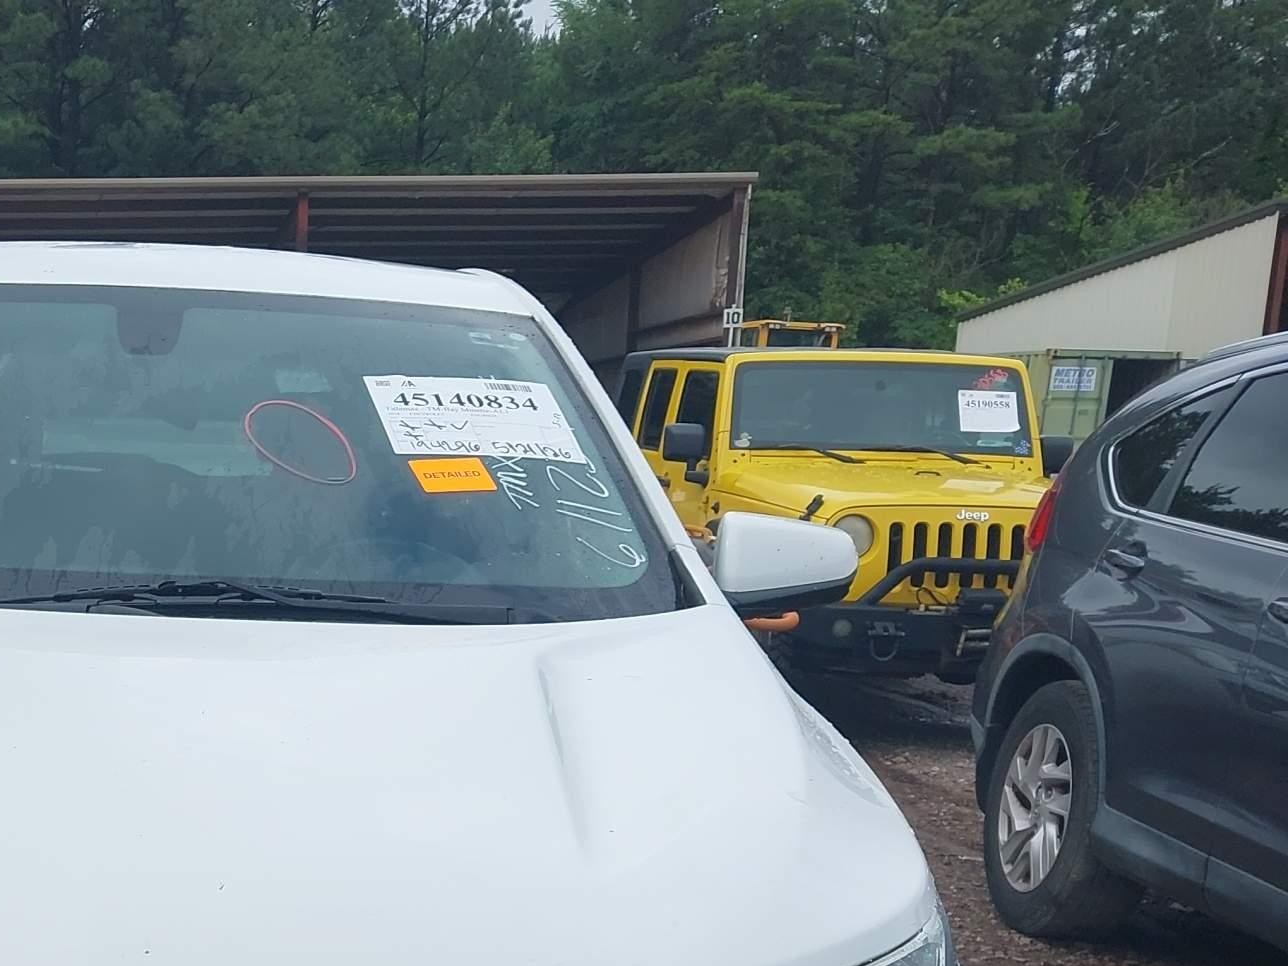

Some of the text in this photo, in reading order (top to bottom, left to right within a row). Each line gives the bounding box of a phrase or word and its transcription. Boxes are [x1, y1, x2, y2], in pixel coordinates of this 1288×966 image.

[726, 311, 740, 324] 10
[393, 392, 539, 411] 45140834
[964, 399, 1011, 409] 45190558
[423, 470, 481, 480] DETAILED
[956, 509, 990, 521] Jeep
